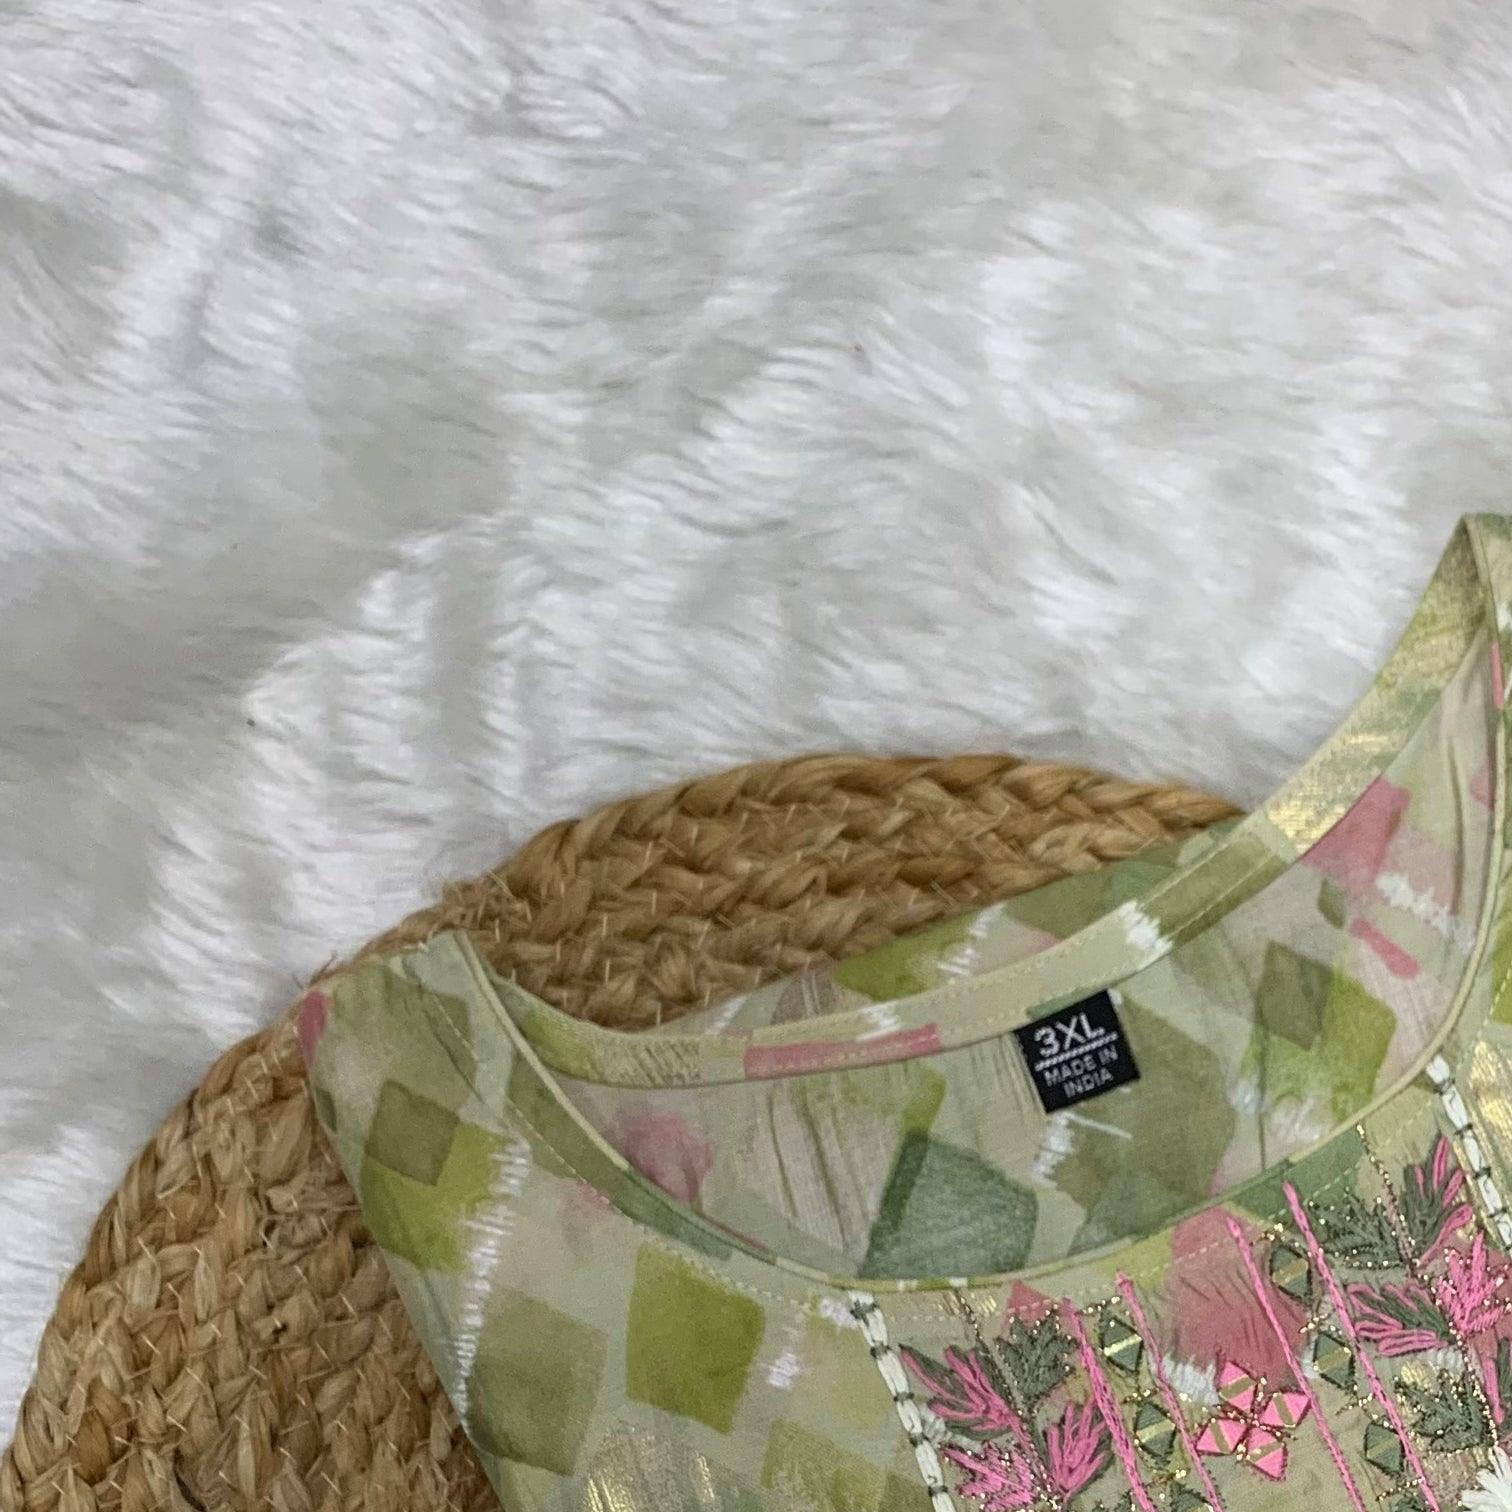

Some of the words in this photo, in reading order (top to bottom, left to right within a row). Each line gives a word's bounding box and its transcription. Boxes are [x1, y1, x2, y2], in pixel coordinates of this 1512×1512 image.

[1034, 1012, 1105, 1057] 3XL
[1044, 1054, 1097, 1087] MADE
[1098, 1044, 1119, 1065] IN
[1063, 1067, 1114, 1098] INDIA
